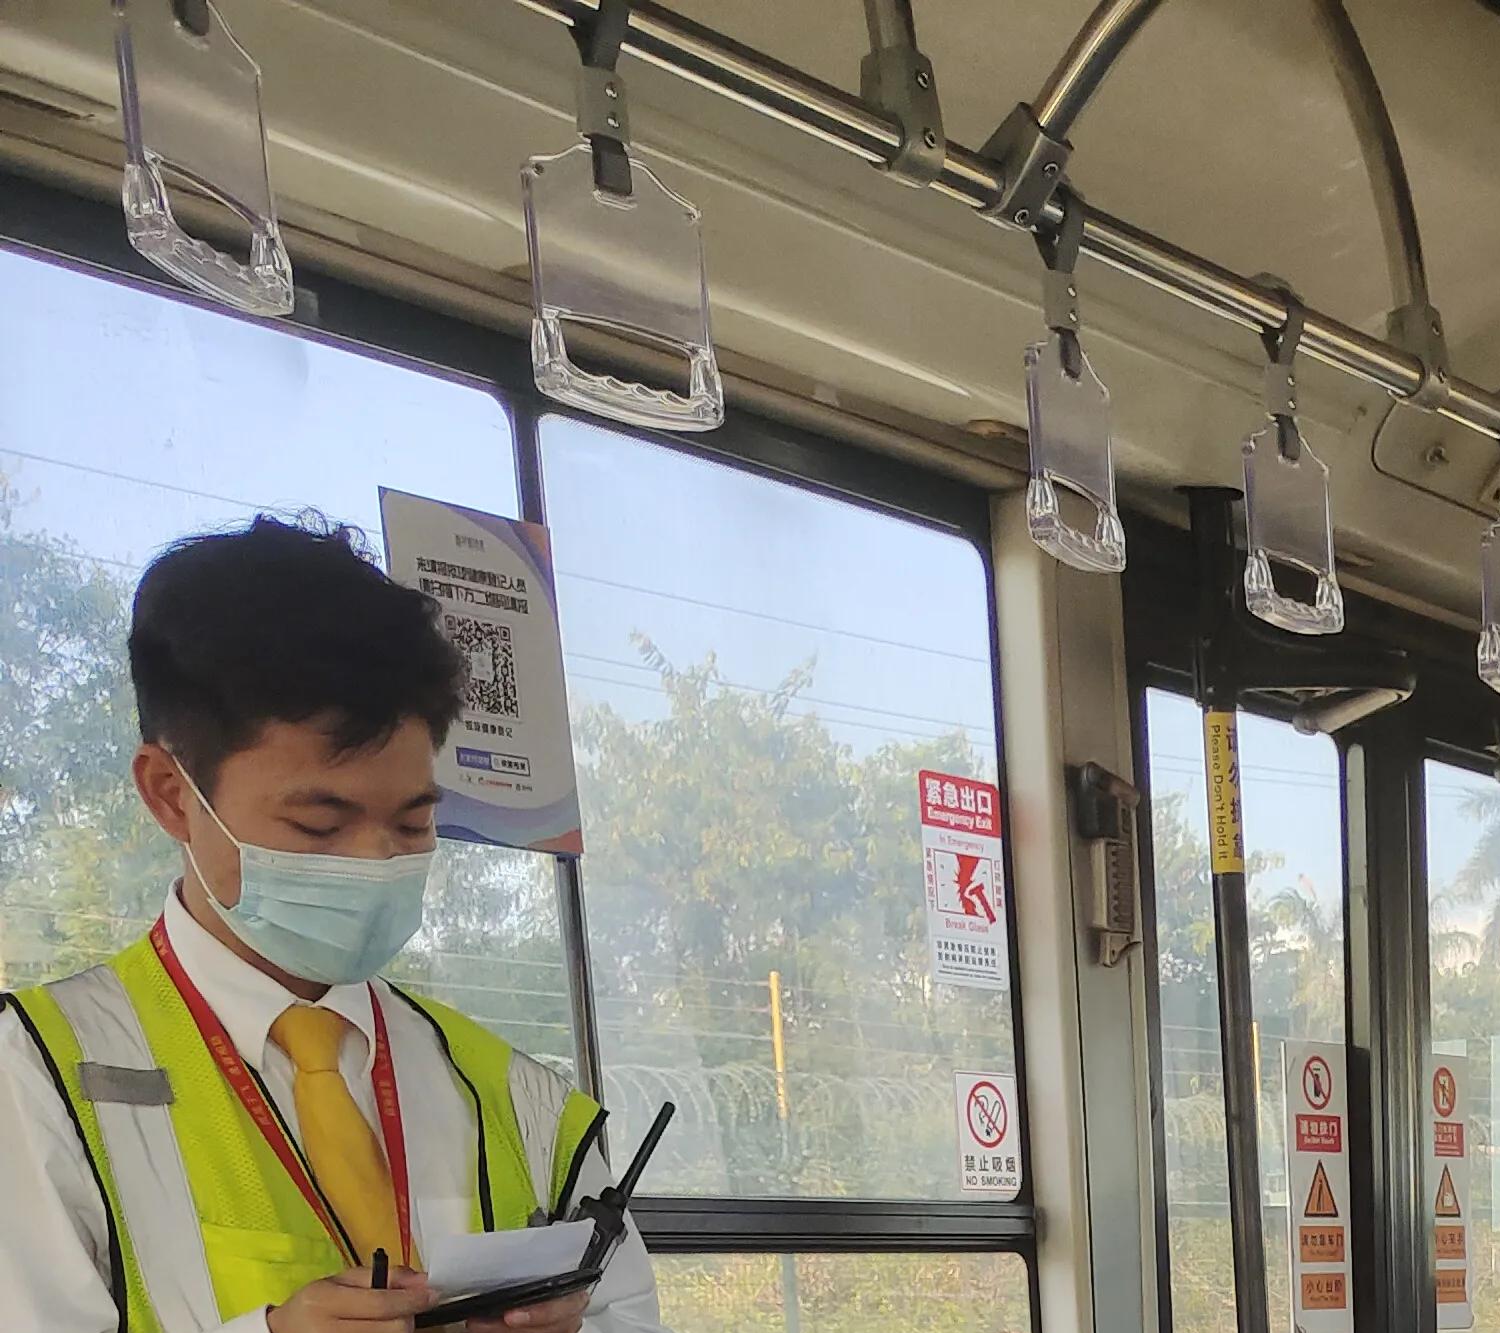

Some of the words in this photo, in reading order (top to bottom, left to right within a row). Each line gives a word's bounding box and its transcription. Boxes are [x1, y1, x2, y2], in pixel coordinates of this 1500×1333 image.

[1210, 724, 1221, 770] Please
[926, 778, 993, 815] 紧急出口
[1213, 775, 1225, 812] Don't
[927, 806, 975, 829] Emergency
[975, 816, 993, 830] Exit
[1216, 815, 1228, 847] Hold
[964, 1154, 1016, 1172] 禁止吸烟
